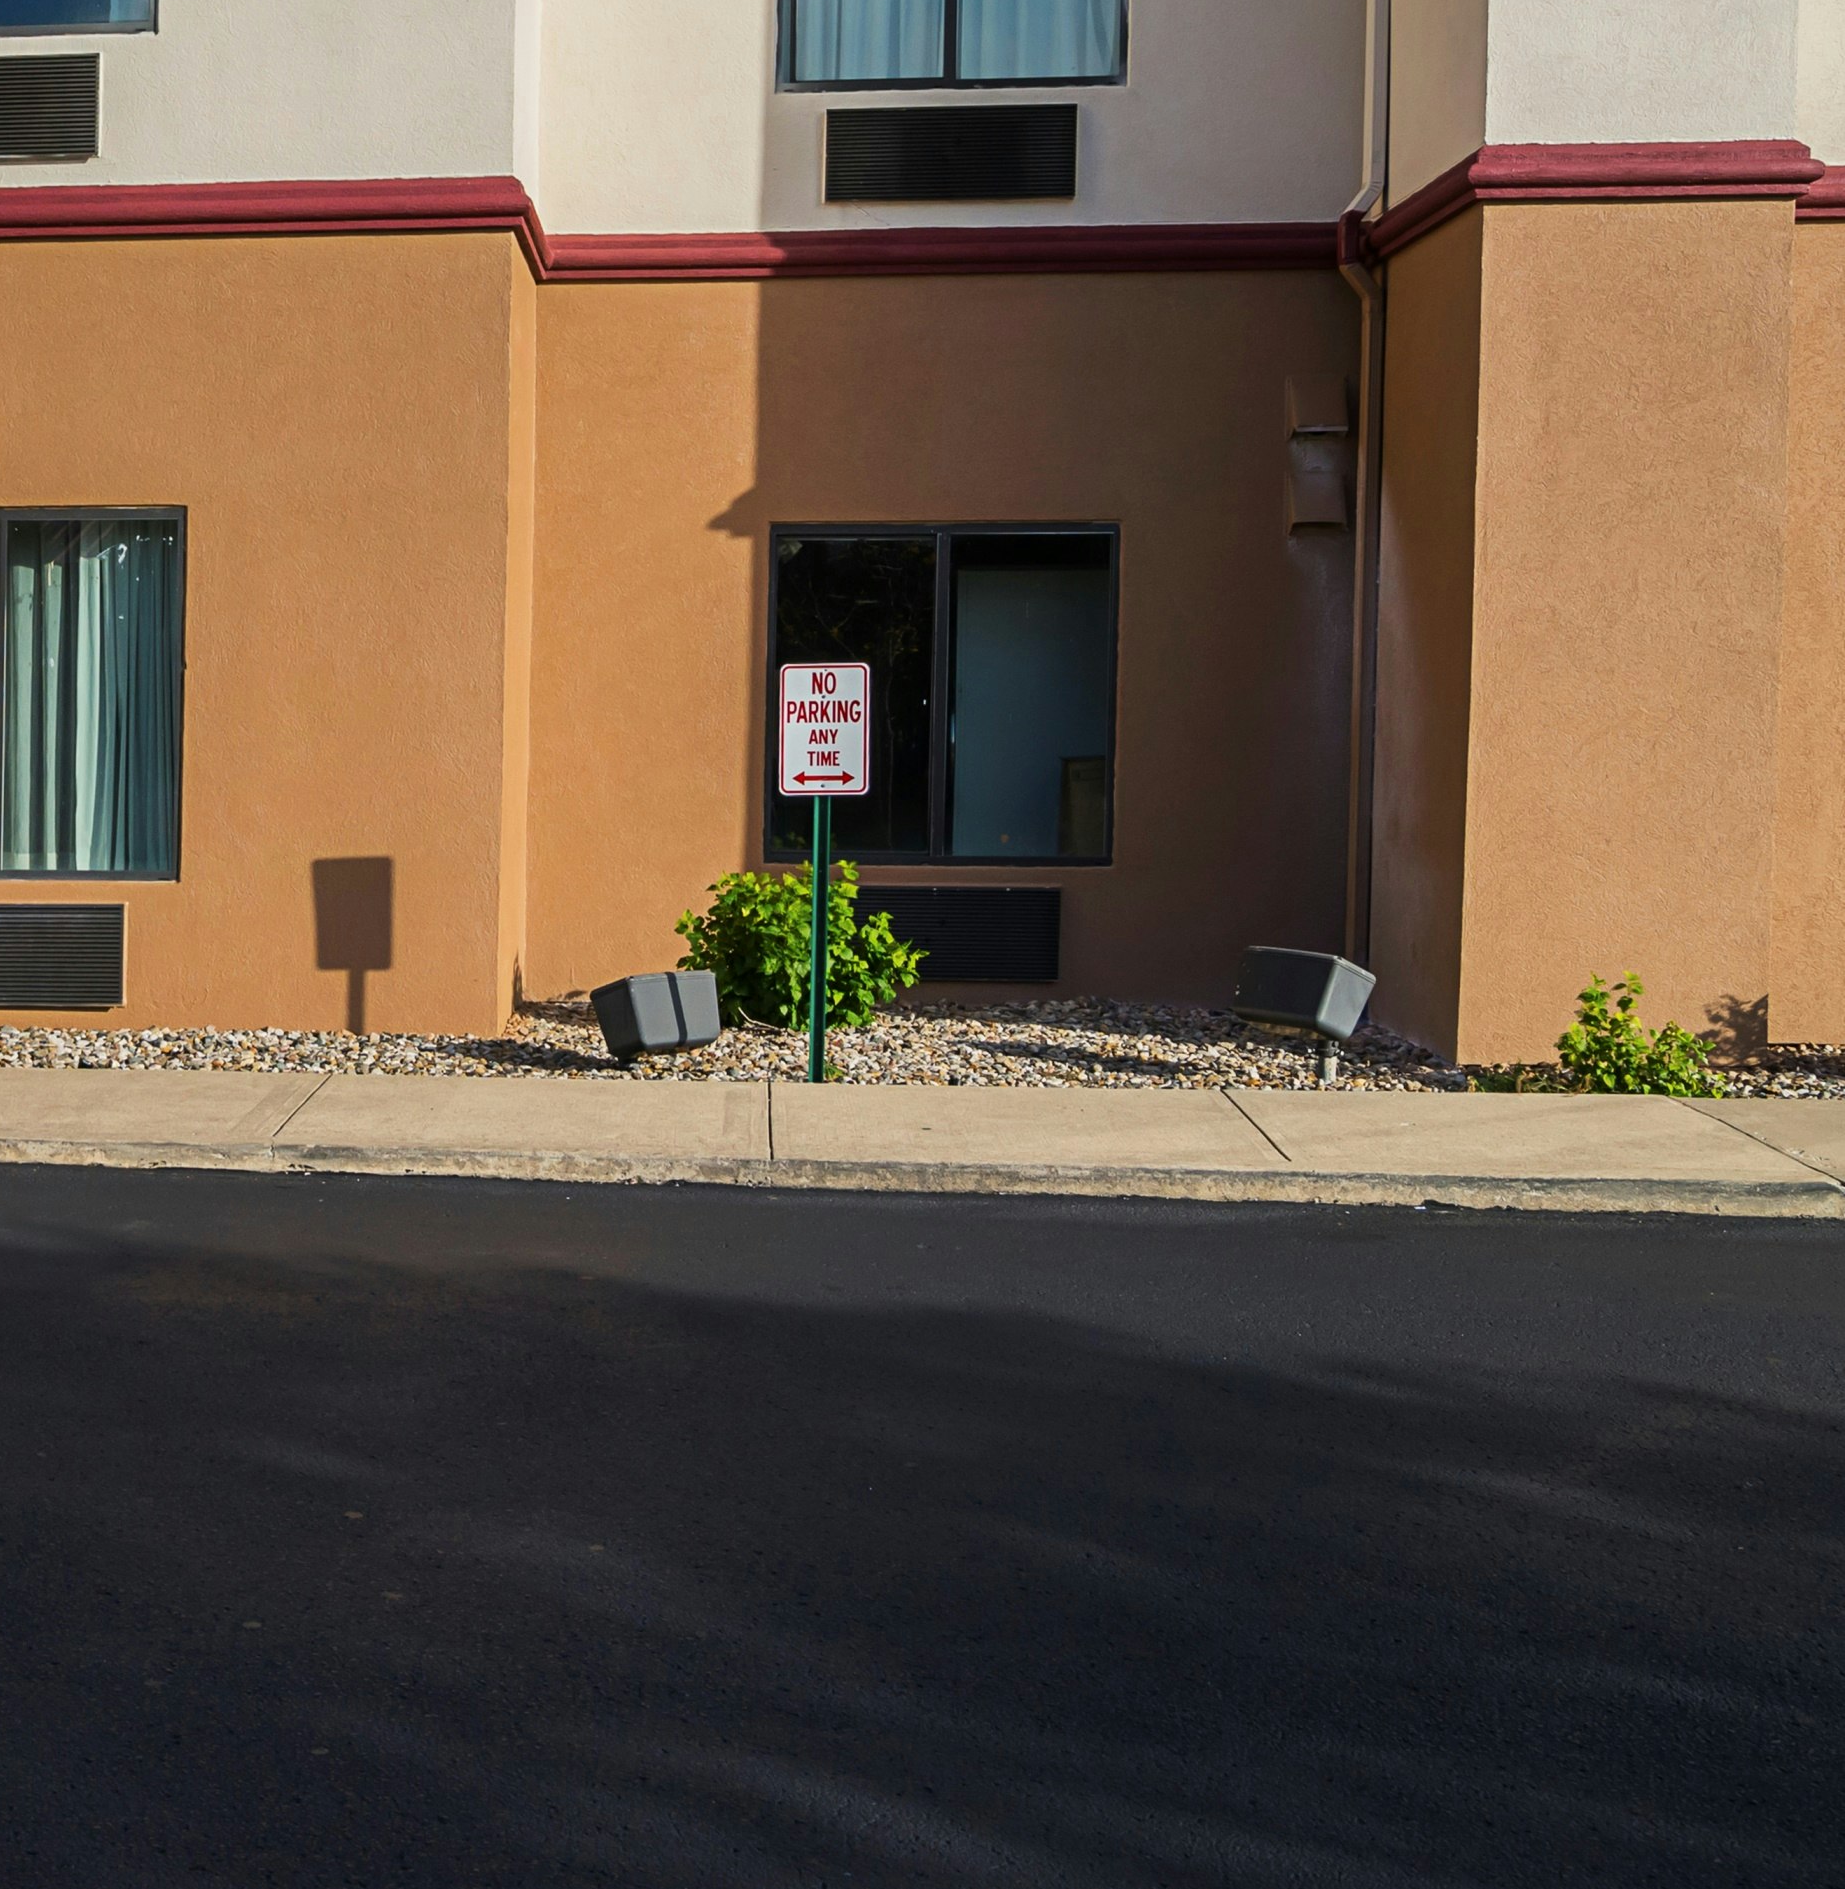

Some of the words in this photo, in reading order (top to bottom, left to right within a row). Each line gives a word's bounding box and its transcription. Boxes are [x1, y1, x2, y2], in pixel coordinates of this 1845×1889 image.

[812, 672, 836, 694] NO
[787, 700, 861, 723] PARKING
[809, 729, 838, 744] ANY
[807, 751, 840, 766] TIME
